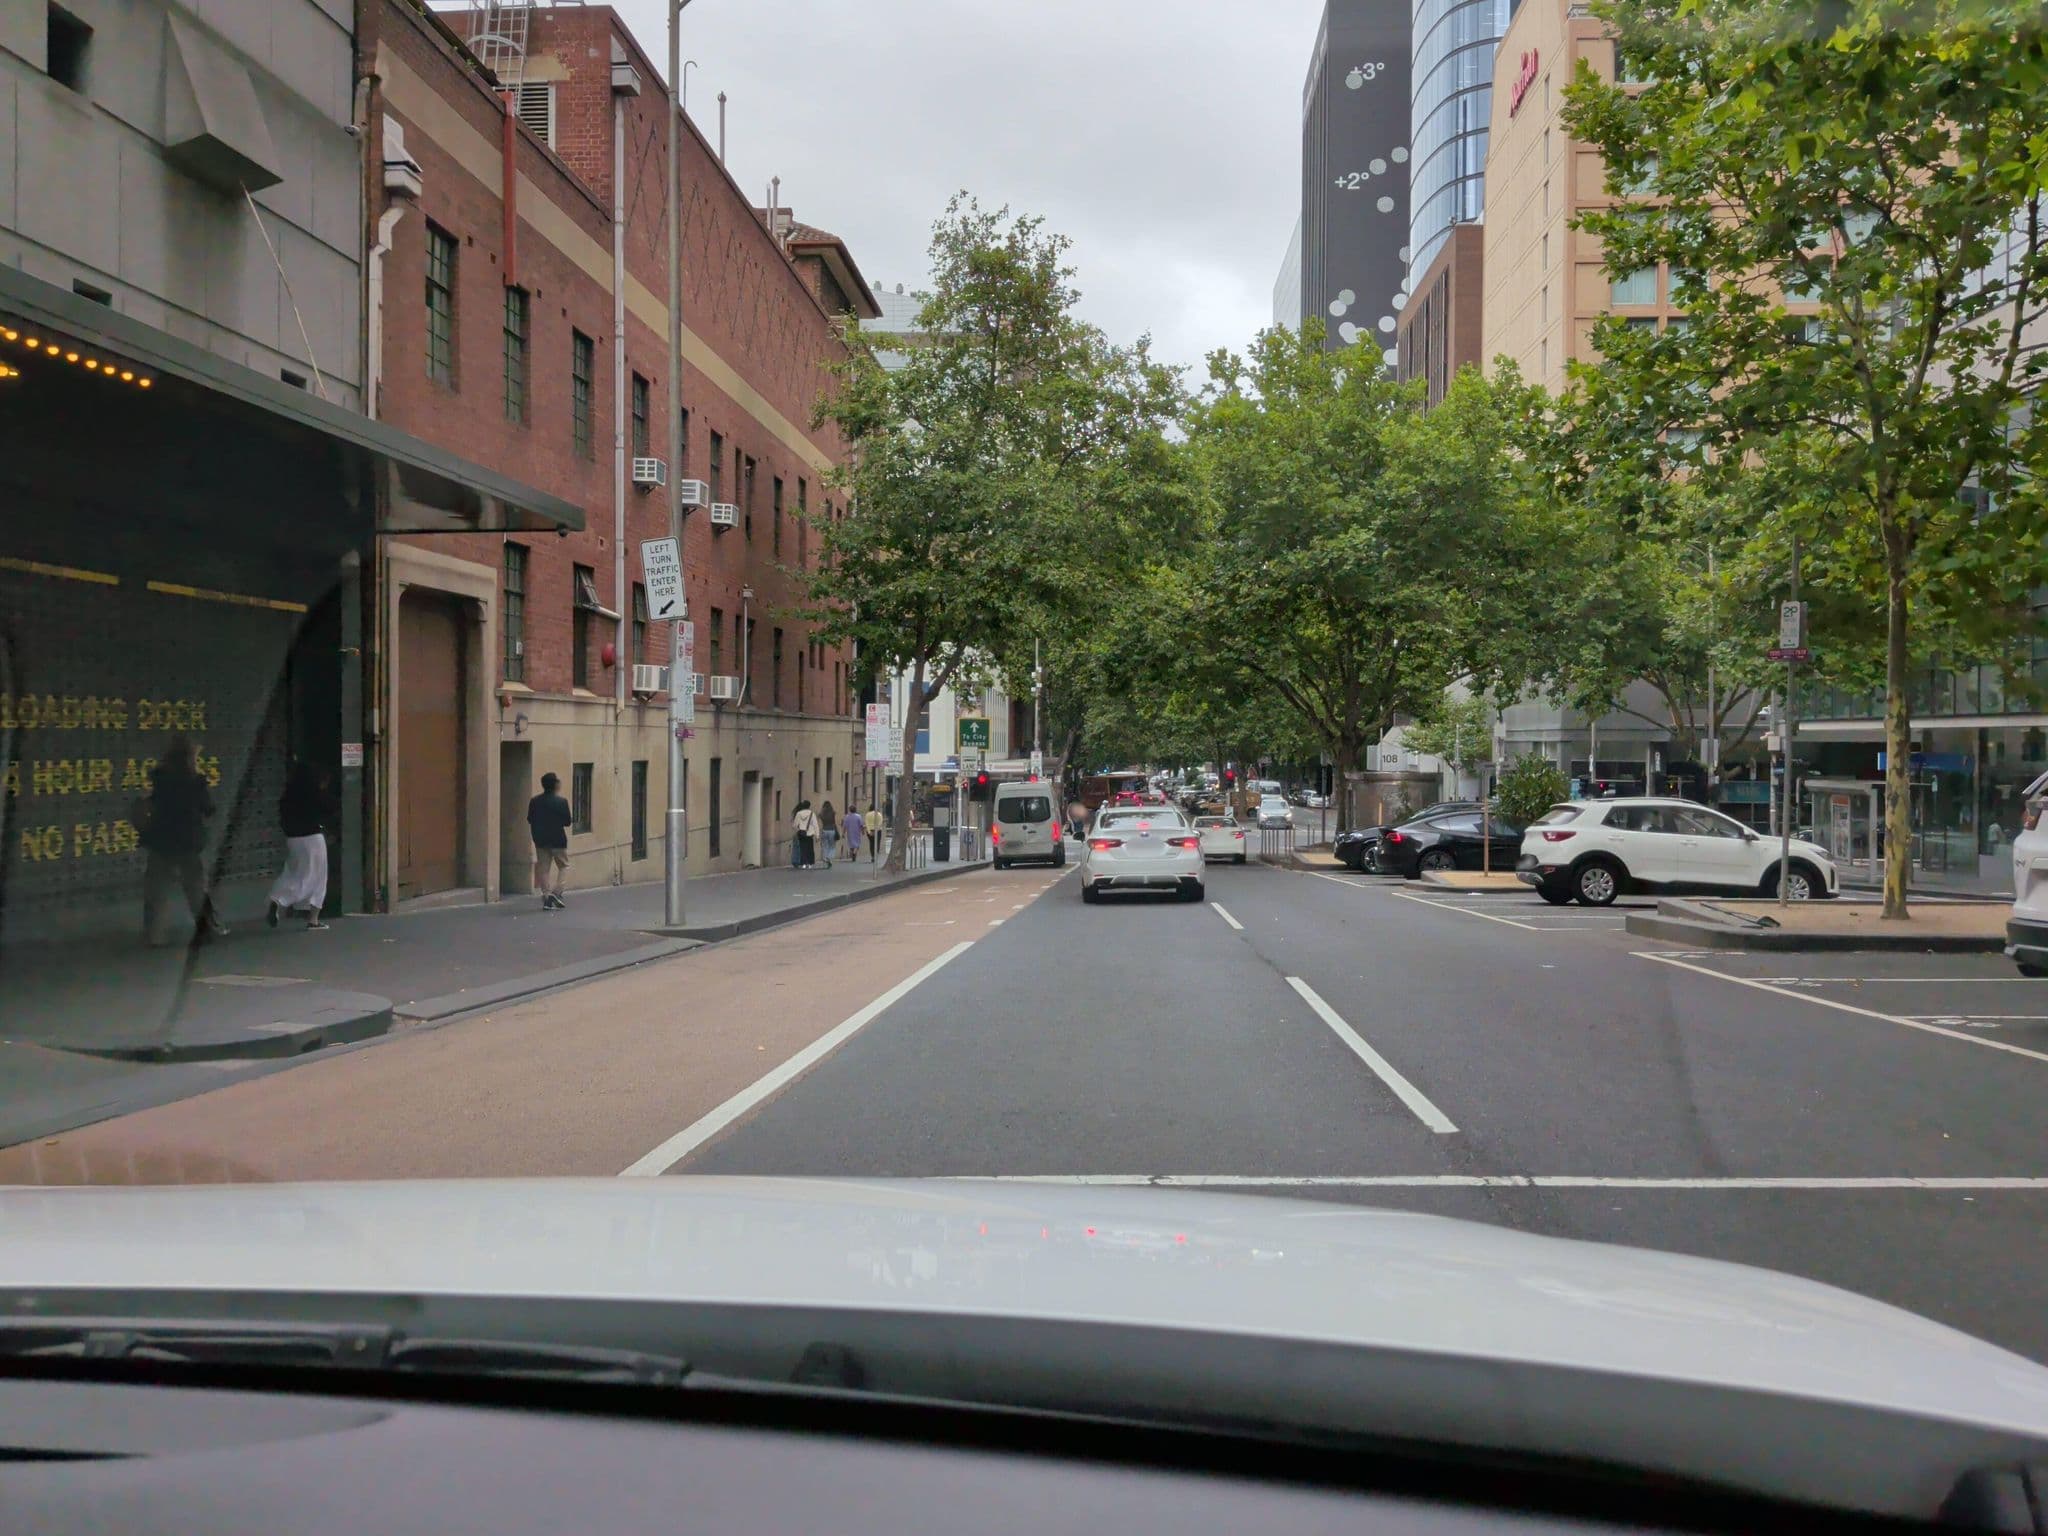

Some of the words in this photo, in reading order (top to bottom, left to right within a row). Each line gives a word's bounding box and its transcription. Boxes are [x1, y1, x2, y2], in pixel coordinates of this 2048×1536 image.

[1334, 172, 1370, 190] +2°
[650, 544, 670, 554] LEFT
[650, 554, 672, 565] TURN
[646, 564, 679, 577] TRAFFIC
[651, 576, 677, 587] ENTER
[655, 586, 676, 597] HERE
[1382, 754, 1399, 764] 108
[33, 758, 114, 796] HOUR
[19, 825, 65, 863] NO
